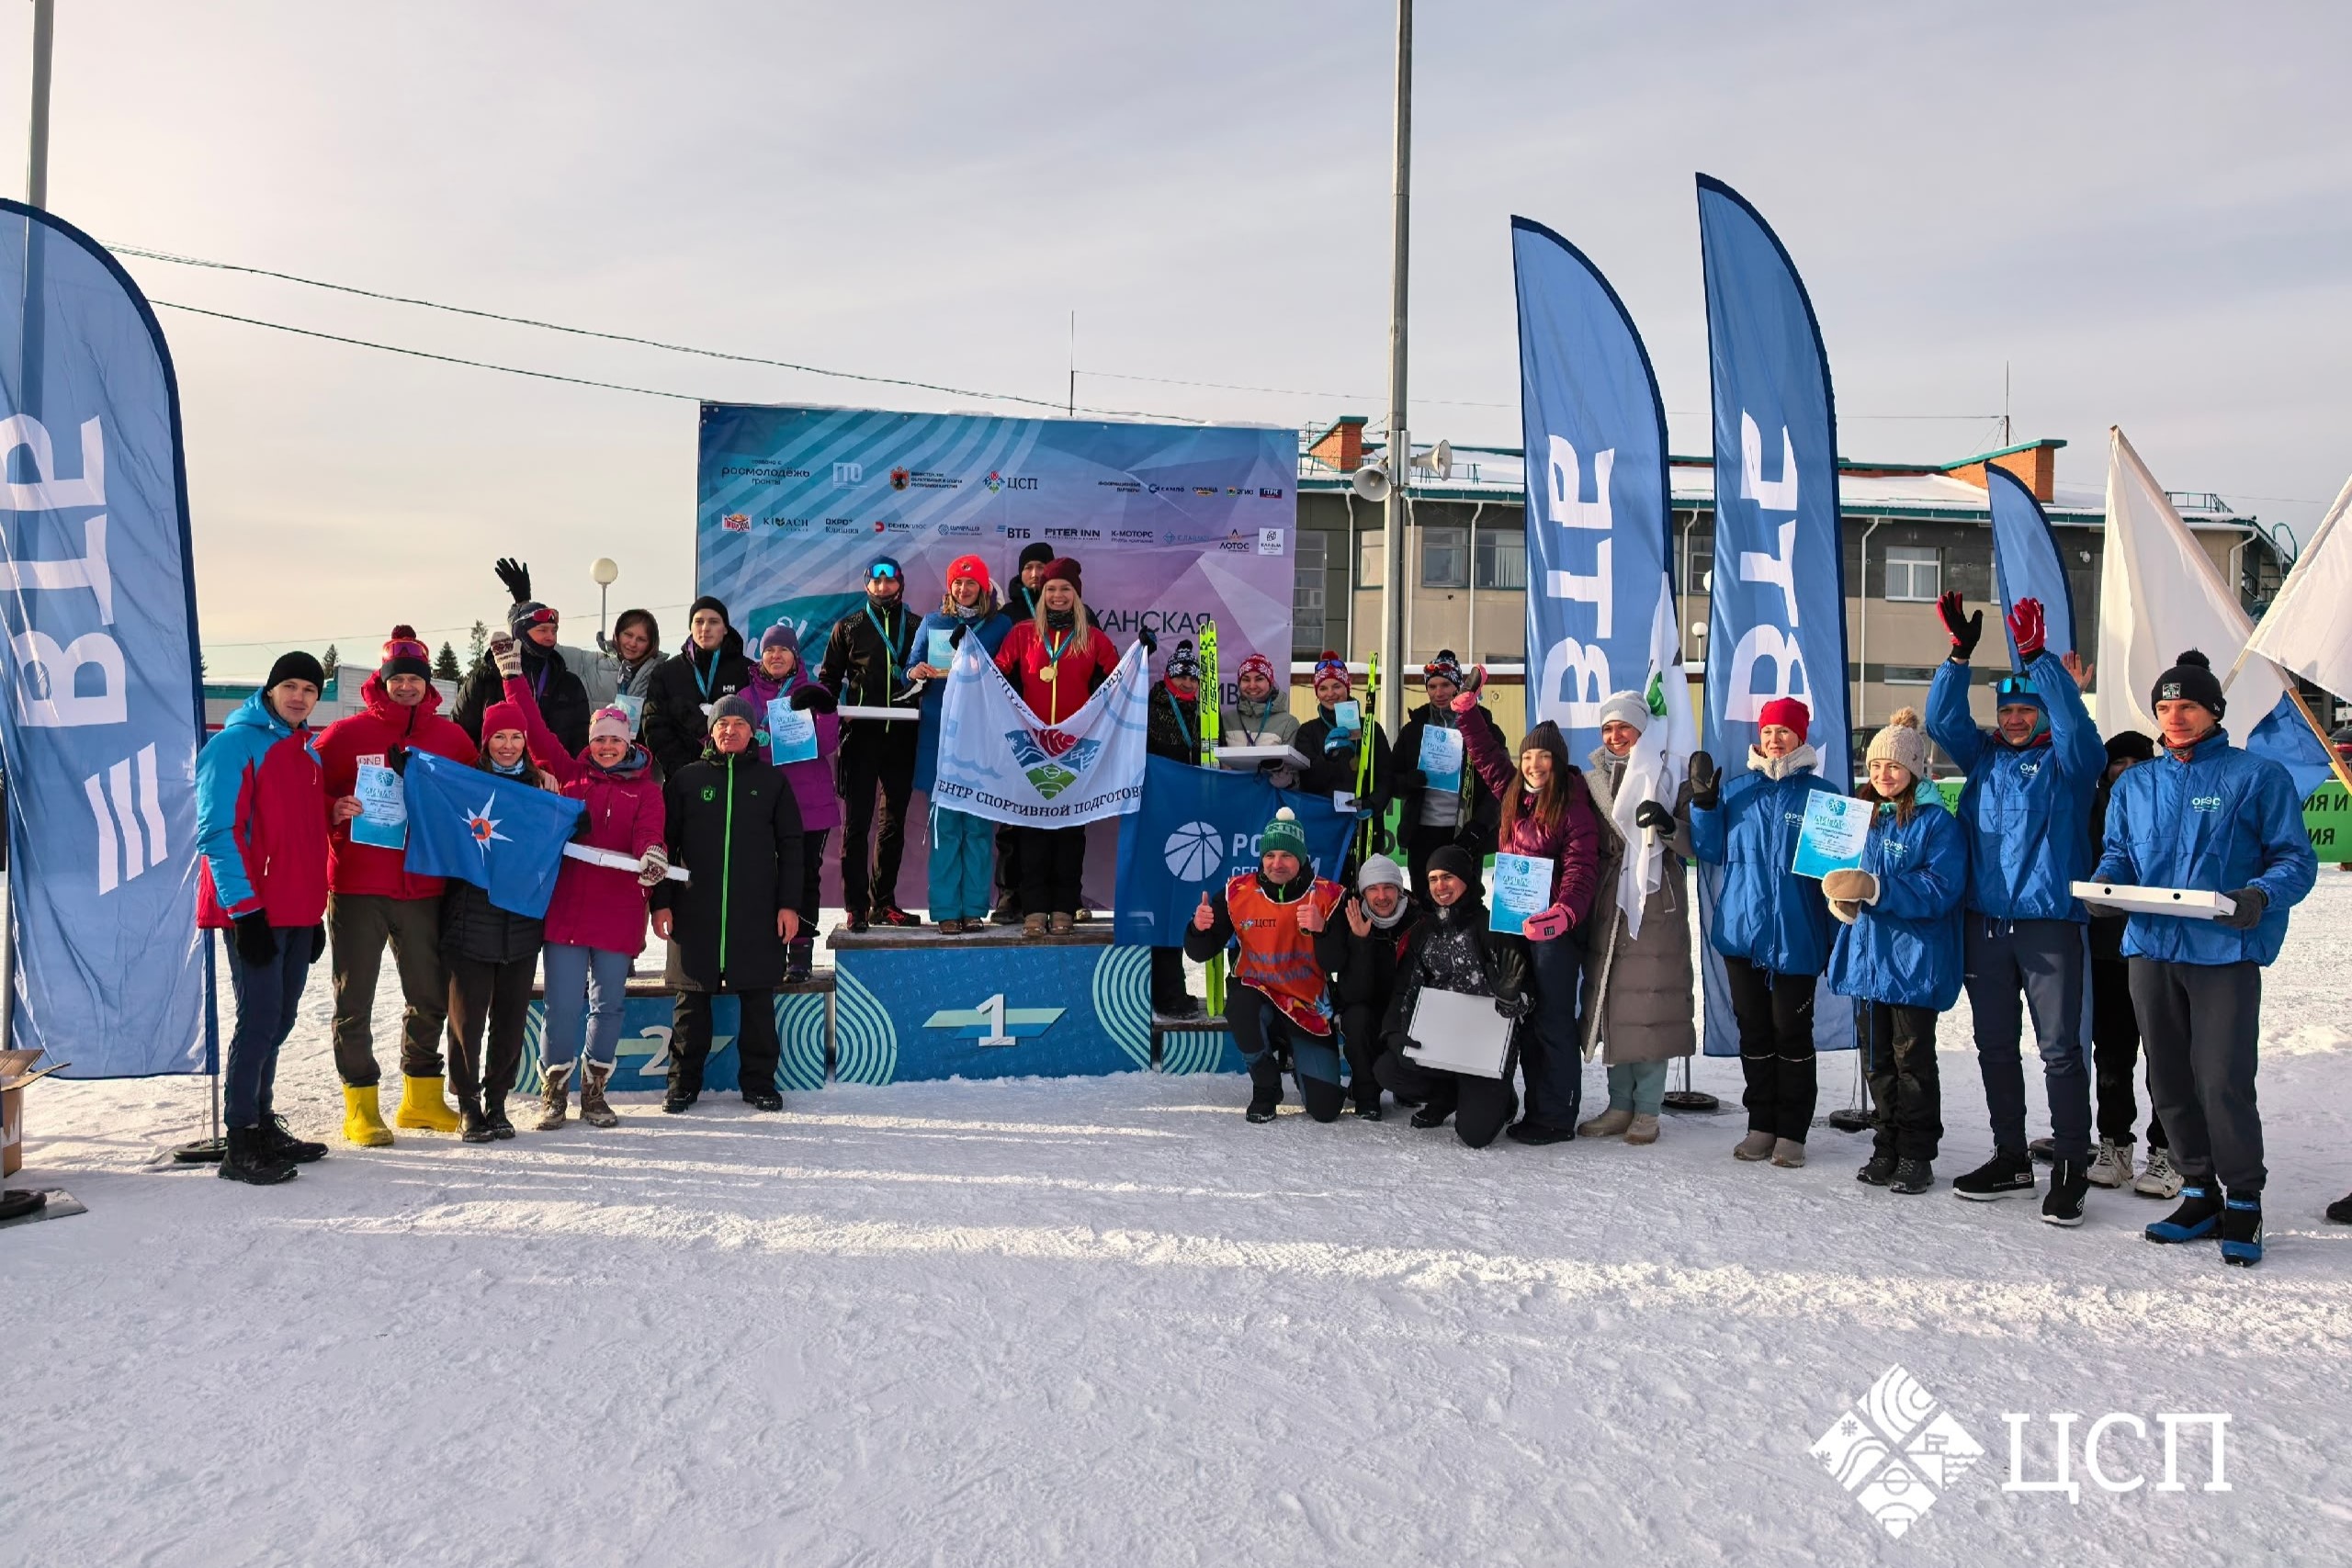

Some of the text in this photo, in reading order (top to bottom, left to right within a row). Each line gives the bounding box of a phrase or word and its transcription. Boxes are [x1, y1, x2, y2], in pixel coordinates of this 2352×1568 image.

[721, 467, 810, 479] росмолодёжь
[833, 462, 864, 483] ГТО
[1007, 477, 1038, 490] ЦСП
[1007, 528, 1031, 539] ВТБ
[1045, 527, 1101, 537] PITER INN
[1111, 530, 1154, 538] К-МОТОРС
[1219, 542, 1250, 550] ЛОТОС
[937, 779, 973, 799] ЕНТР
[976, 792, 1070, 817] СПОРТИВНОЙ
[1255, 919, 1277, 929] ЦСП
[975, 994, 1016, 1047] 1
[639, 1025, 673, 1077] 2
